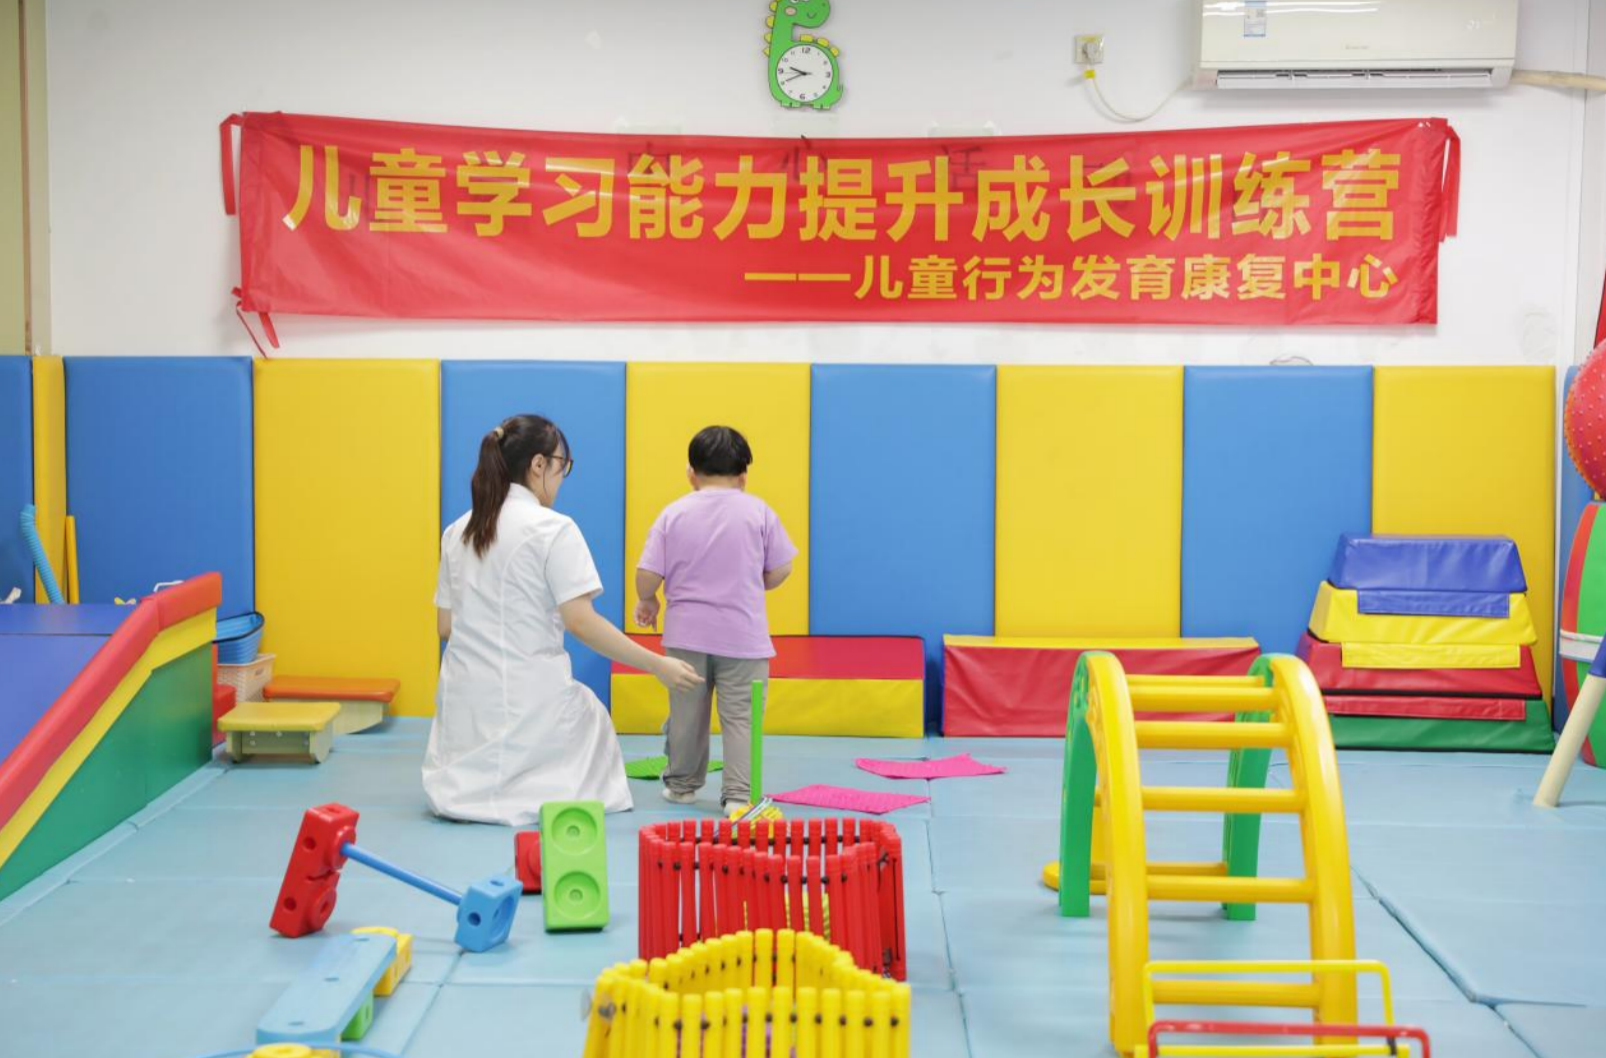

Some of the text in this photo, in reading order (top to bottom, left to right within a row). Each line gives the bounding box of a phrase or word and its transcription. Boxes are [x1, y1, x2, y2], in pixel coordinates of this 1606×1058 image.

[282, 145, 1401, 241] 儿童学习能力提升成长训练营
